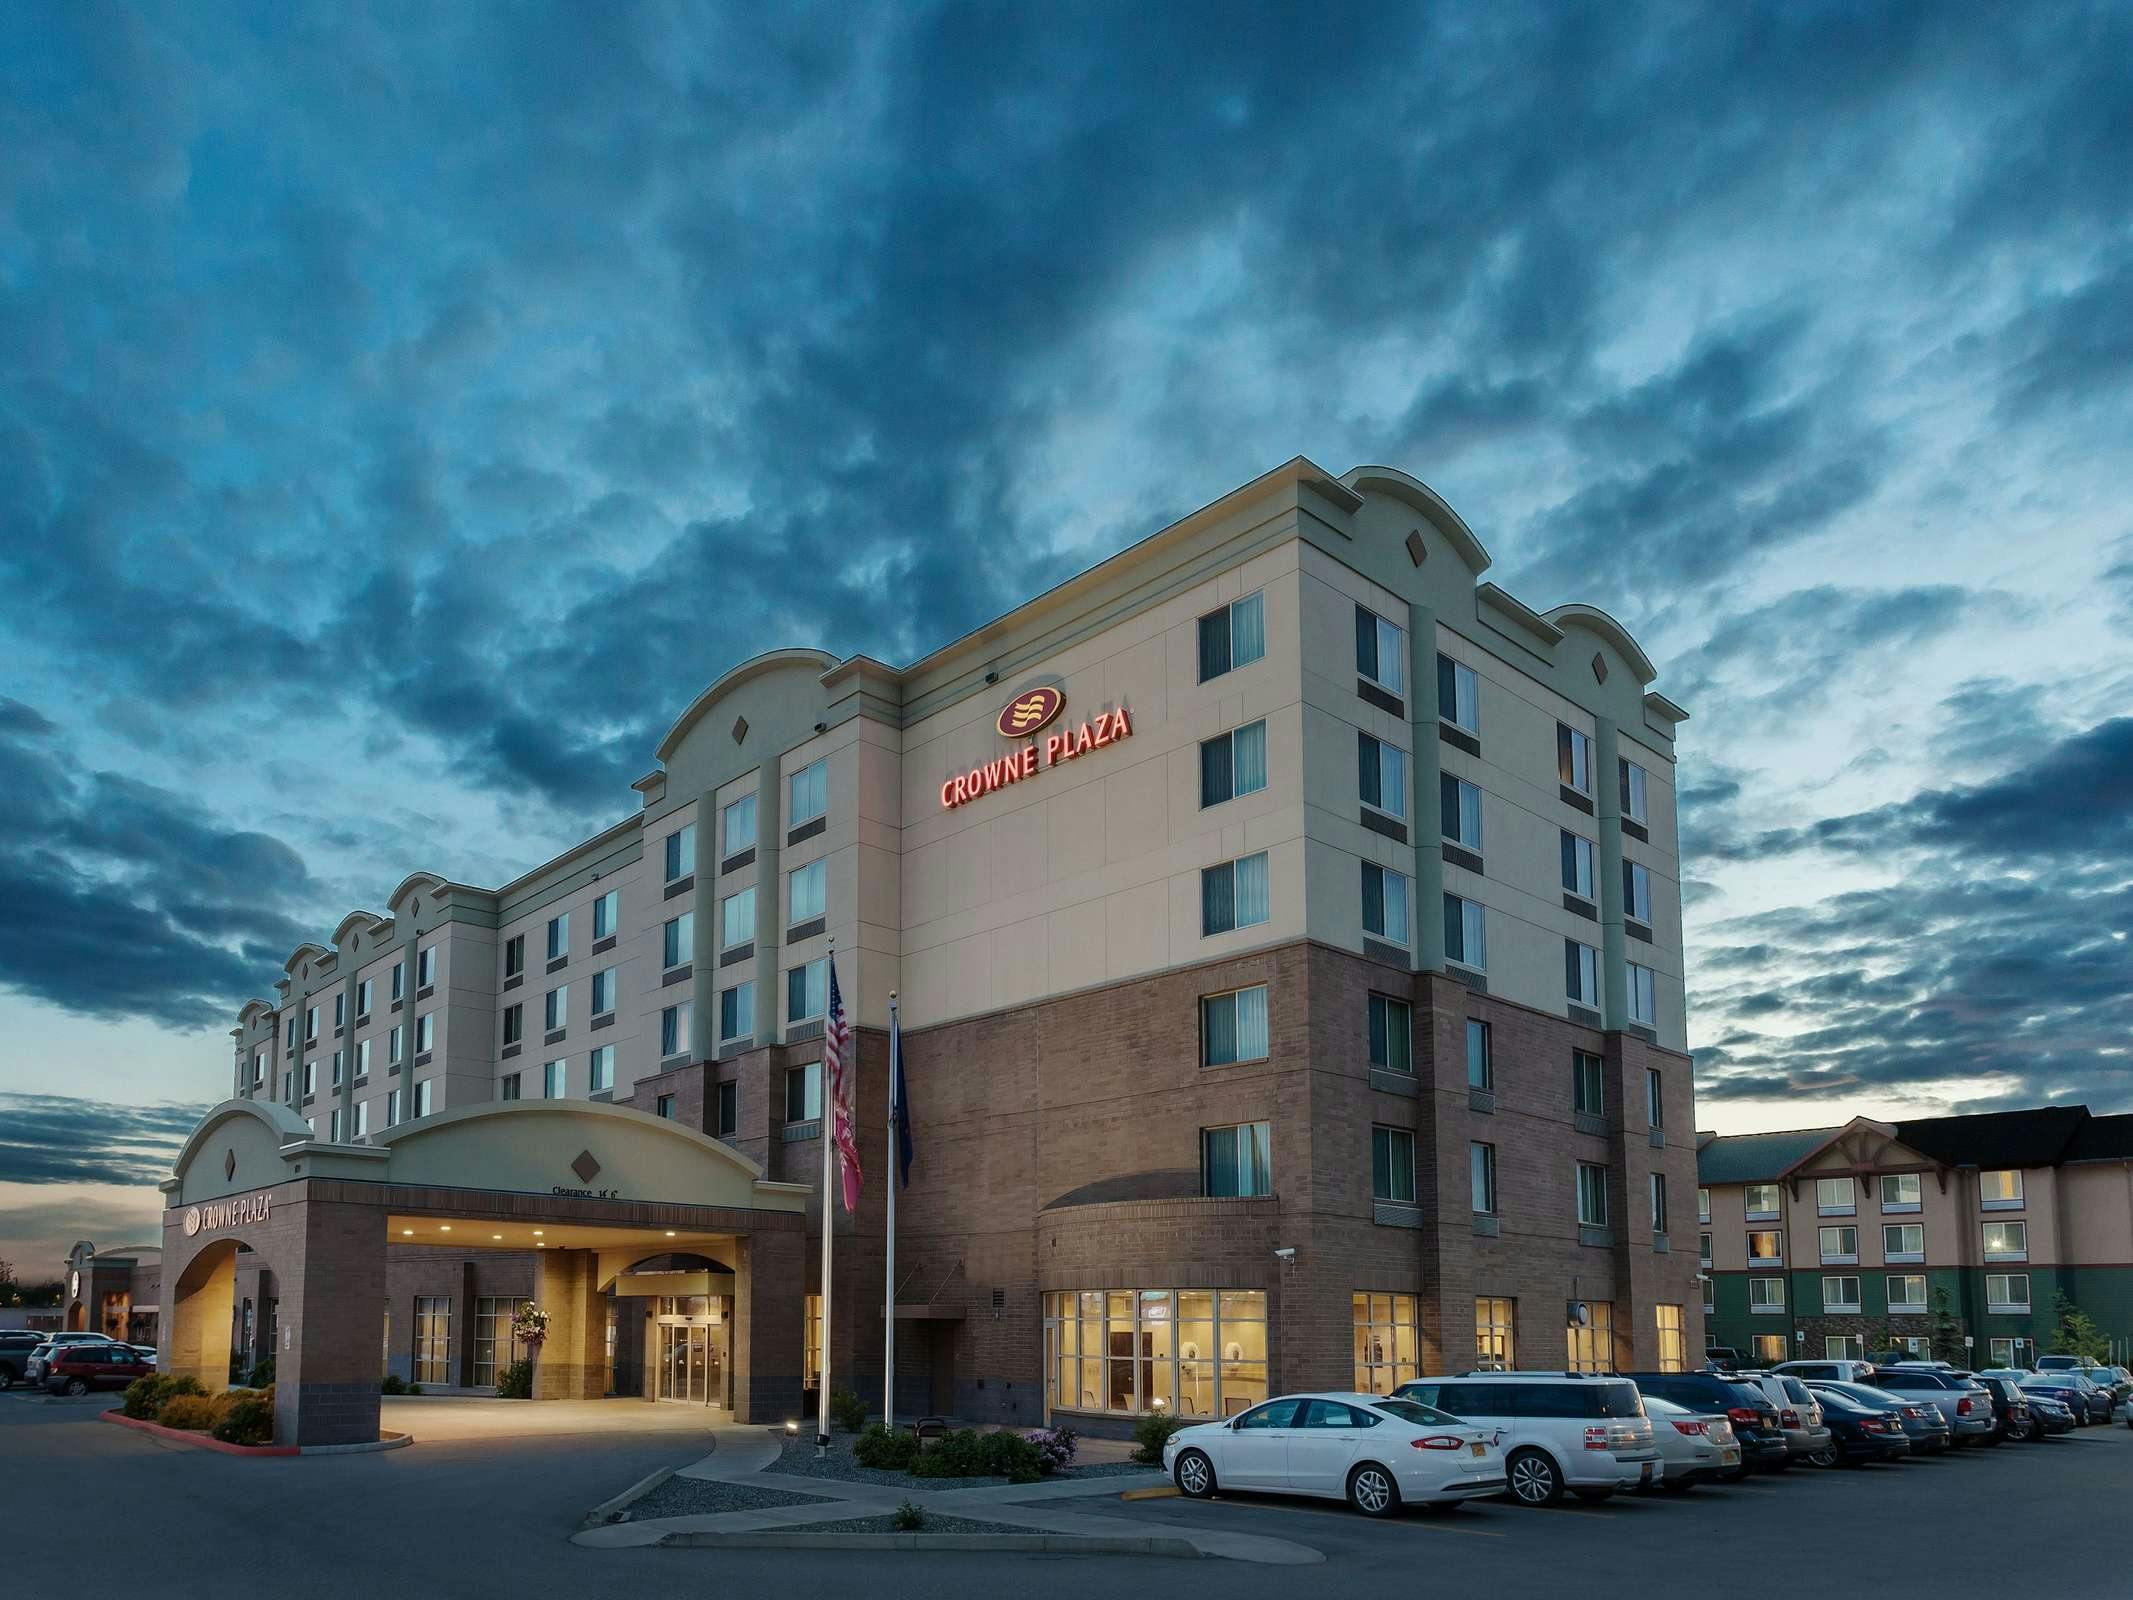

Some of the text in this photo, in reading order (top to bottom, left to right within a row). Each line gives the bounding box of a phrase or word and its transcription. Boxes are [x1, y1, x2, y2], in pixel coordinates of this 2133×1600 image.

[941, 706, 1131, 808] CROWNE PLAZA
[552, 1186, 592, 1198] Clearance
[202, 1194, 270, 1231] CROWNE PLAZA
